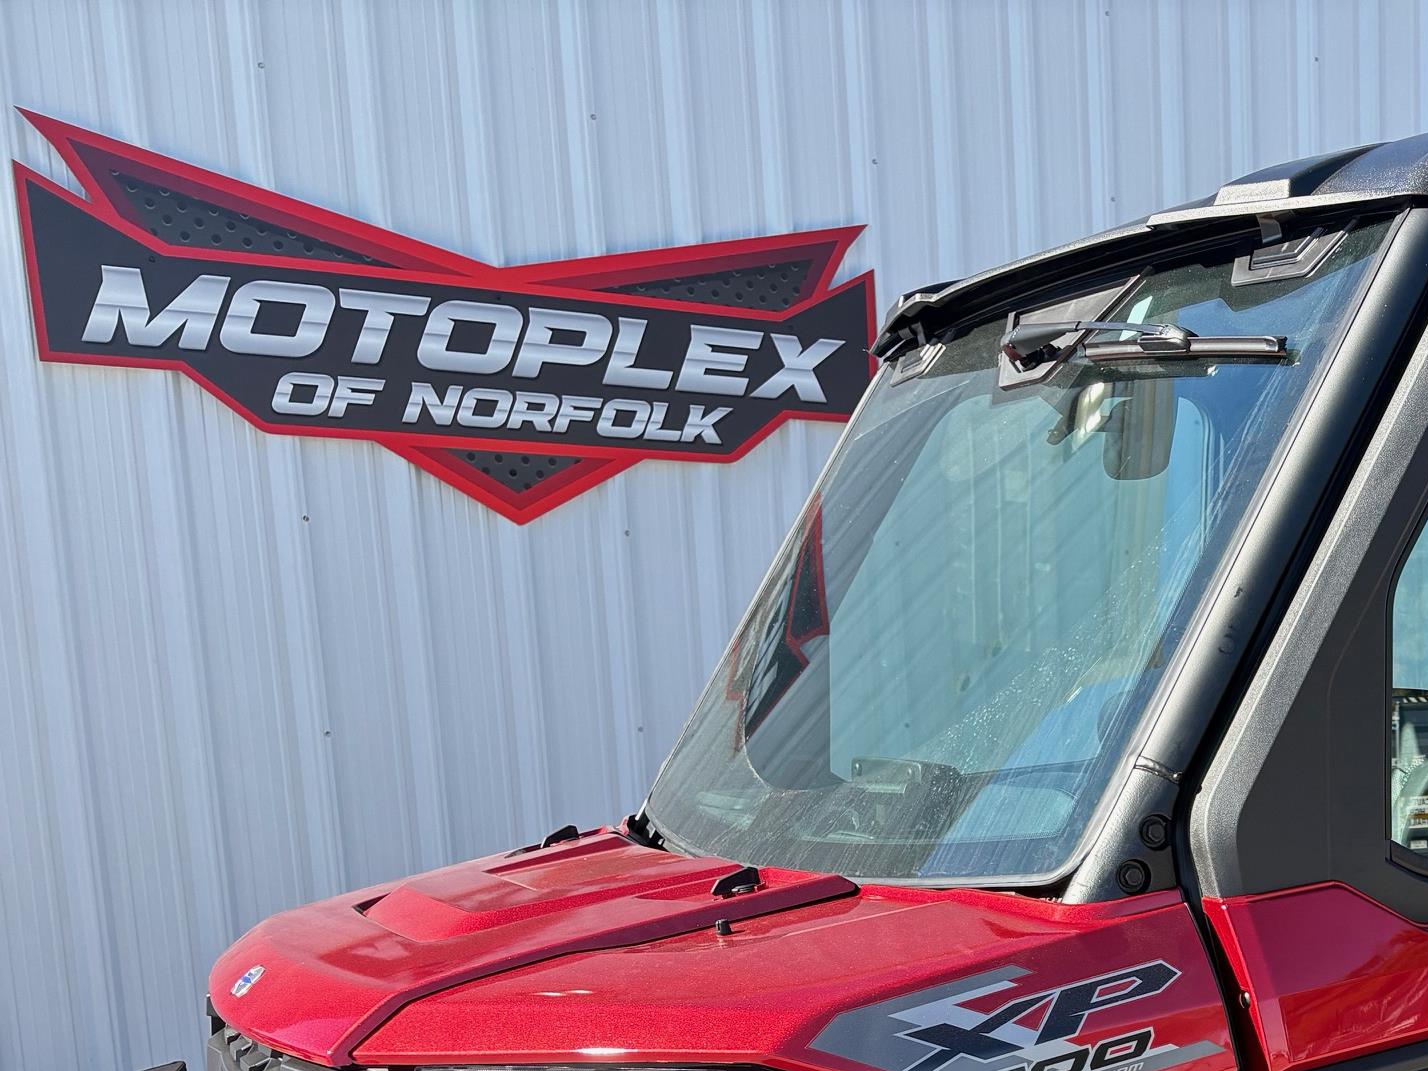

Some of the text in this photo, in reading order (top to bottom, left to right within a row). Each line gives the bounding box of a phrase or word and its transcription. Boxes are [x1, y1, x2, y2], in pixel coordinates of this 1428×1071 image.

[81, 264, 845, 403] MOTOPLEX
[271, 372, 734, 446] OF NORFOLK
